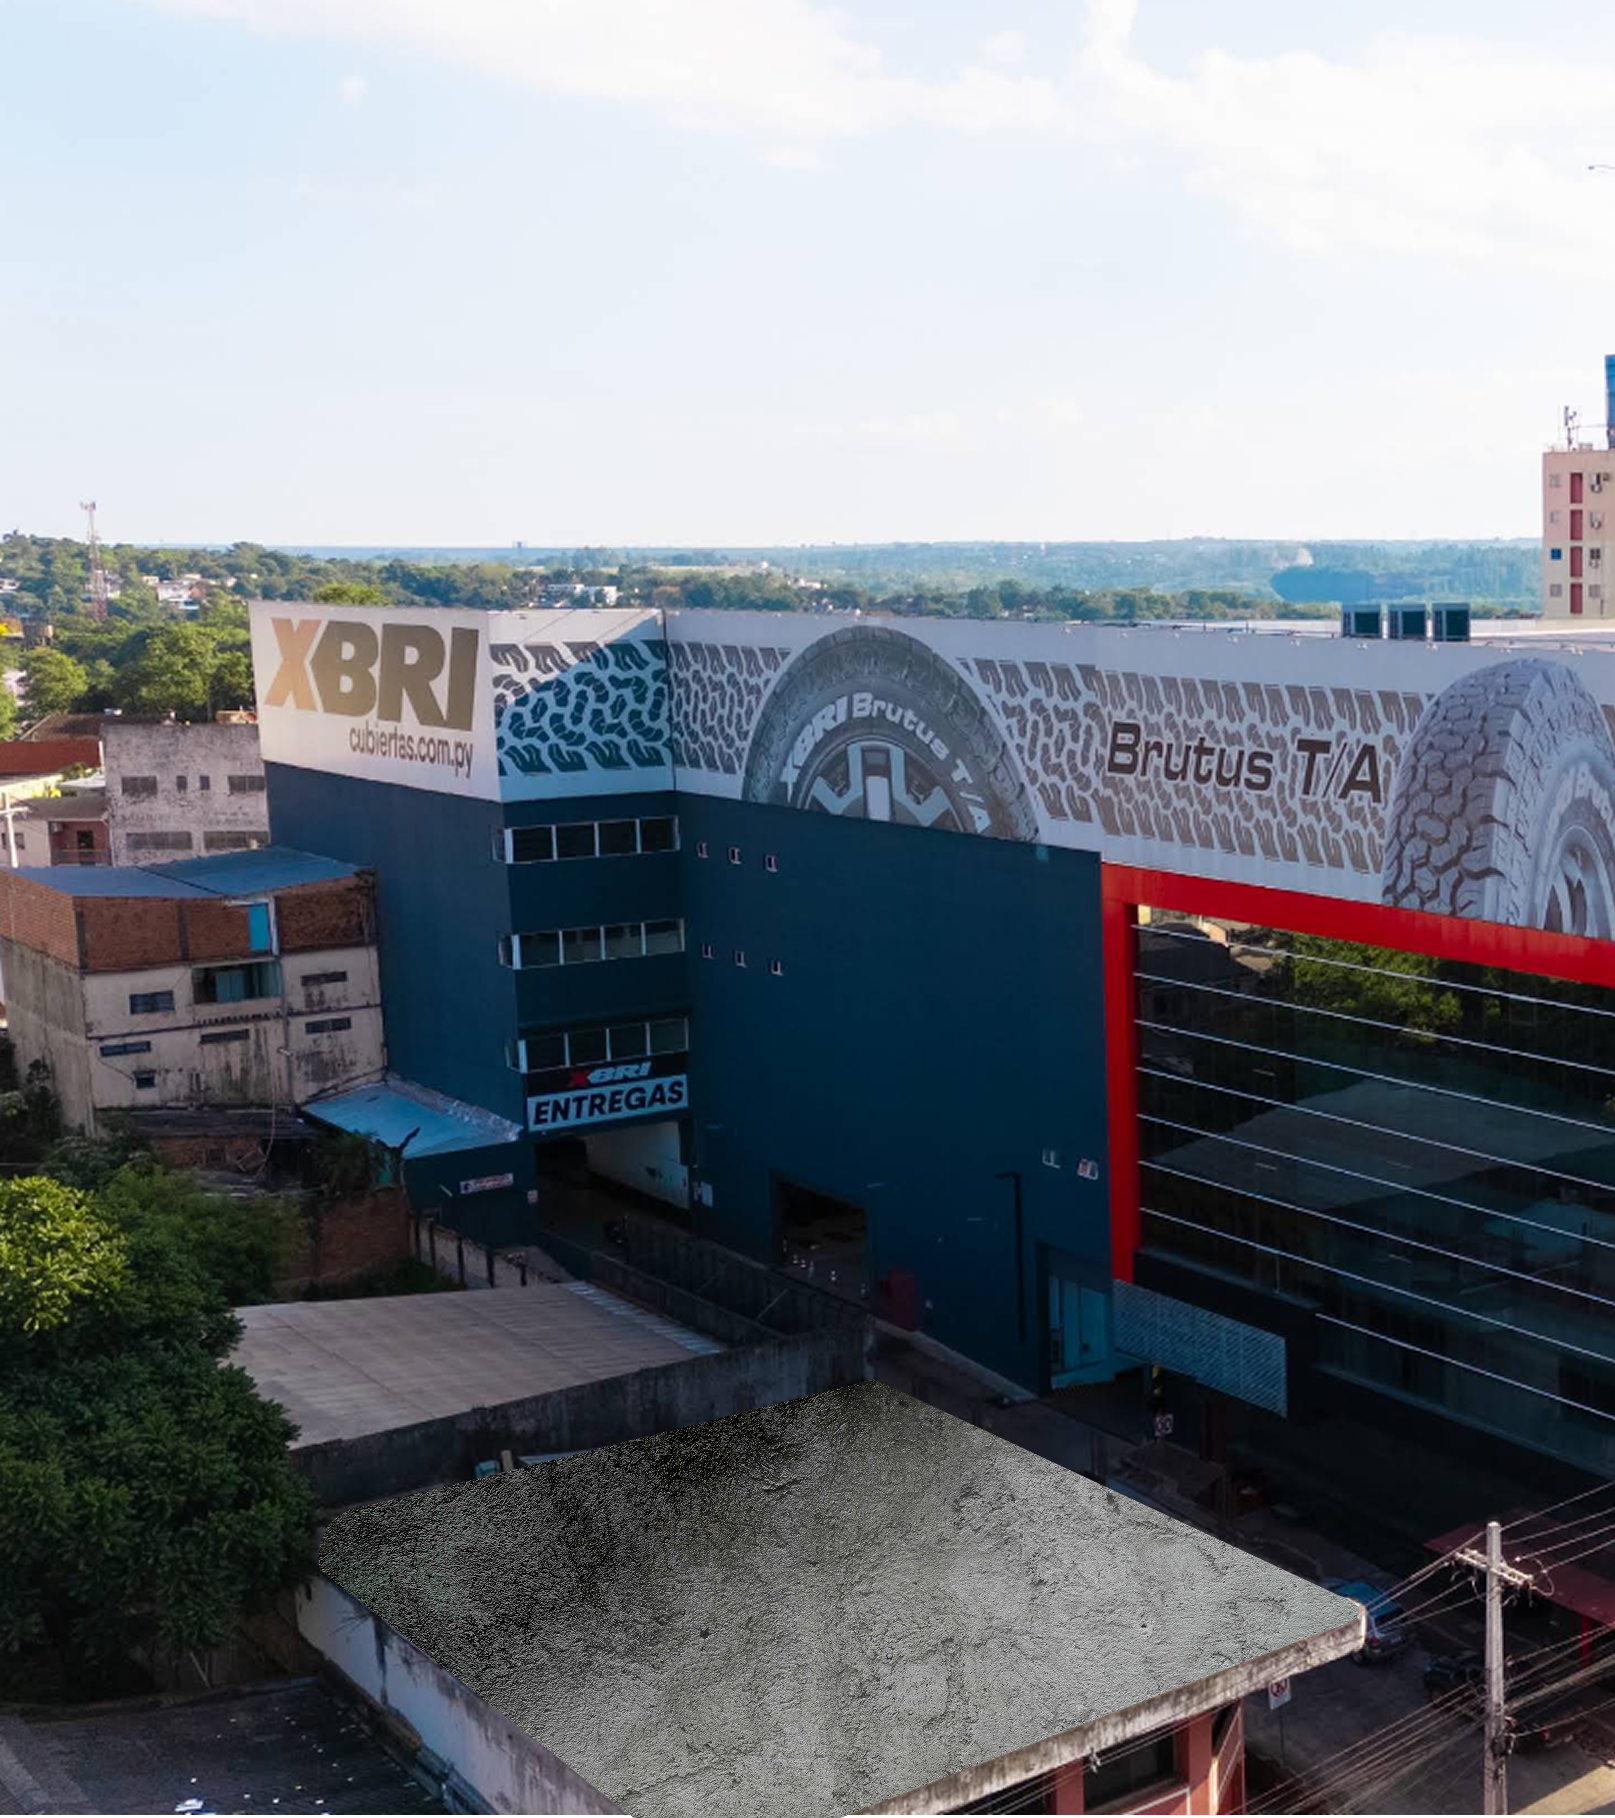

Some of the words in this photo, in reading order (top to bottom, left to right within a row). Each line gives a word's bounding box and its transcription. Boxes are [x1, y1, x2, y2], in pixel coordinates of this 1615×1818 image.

[264, 617, 480, 732] XBRI
[348, 721, 475, 779] cubiertas.com.py
[851, 692, 950, 761] Brutus
[951, 759, 991, 834] T/A
[1107, 722, 1275, 791] Brutus
[1295, 738, 1384, 804] T/A
[533, 1081, 684, 1125] ENTREGAS
[567, 1061, 653, 1088] XBRI
